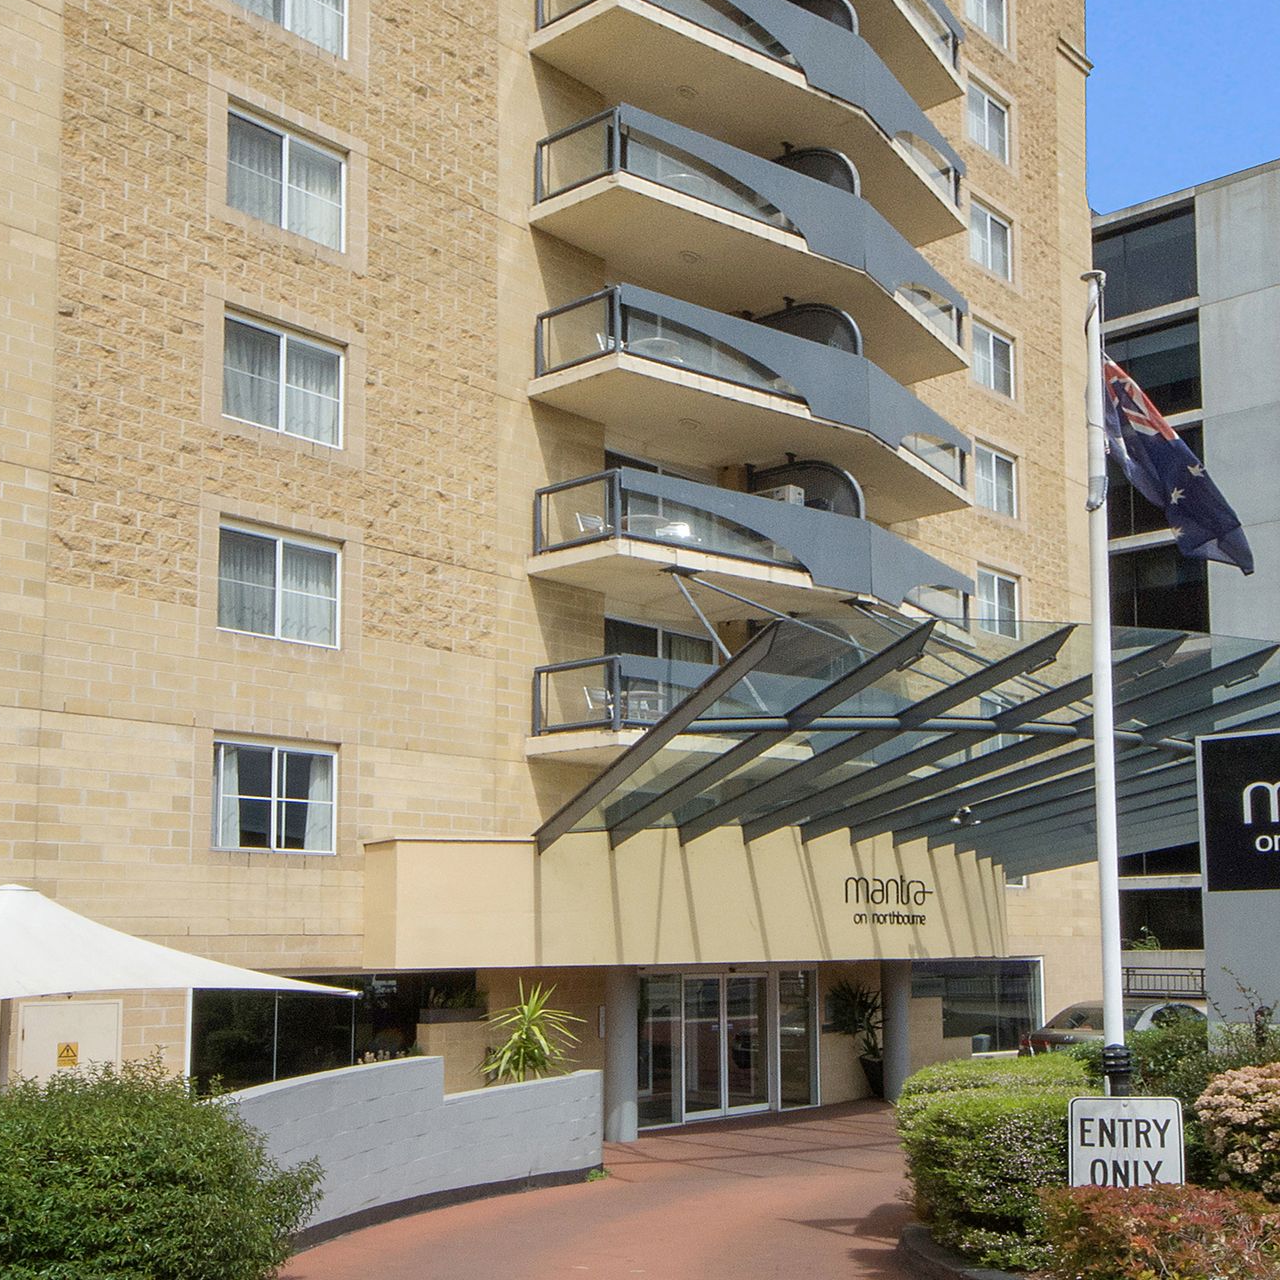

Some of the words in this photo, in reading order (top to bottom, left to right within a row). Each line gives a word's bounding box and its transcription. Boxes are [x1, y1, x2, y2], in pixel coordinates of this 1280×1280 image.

[844, 874, 934, 906] mantra
[853, 912, 868, 924] on
[871, 911, 926, 926] northbourne
[1079, 1118, 1171, 1148] ENTRY
